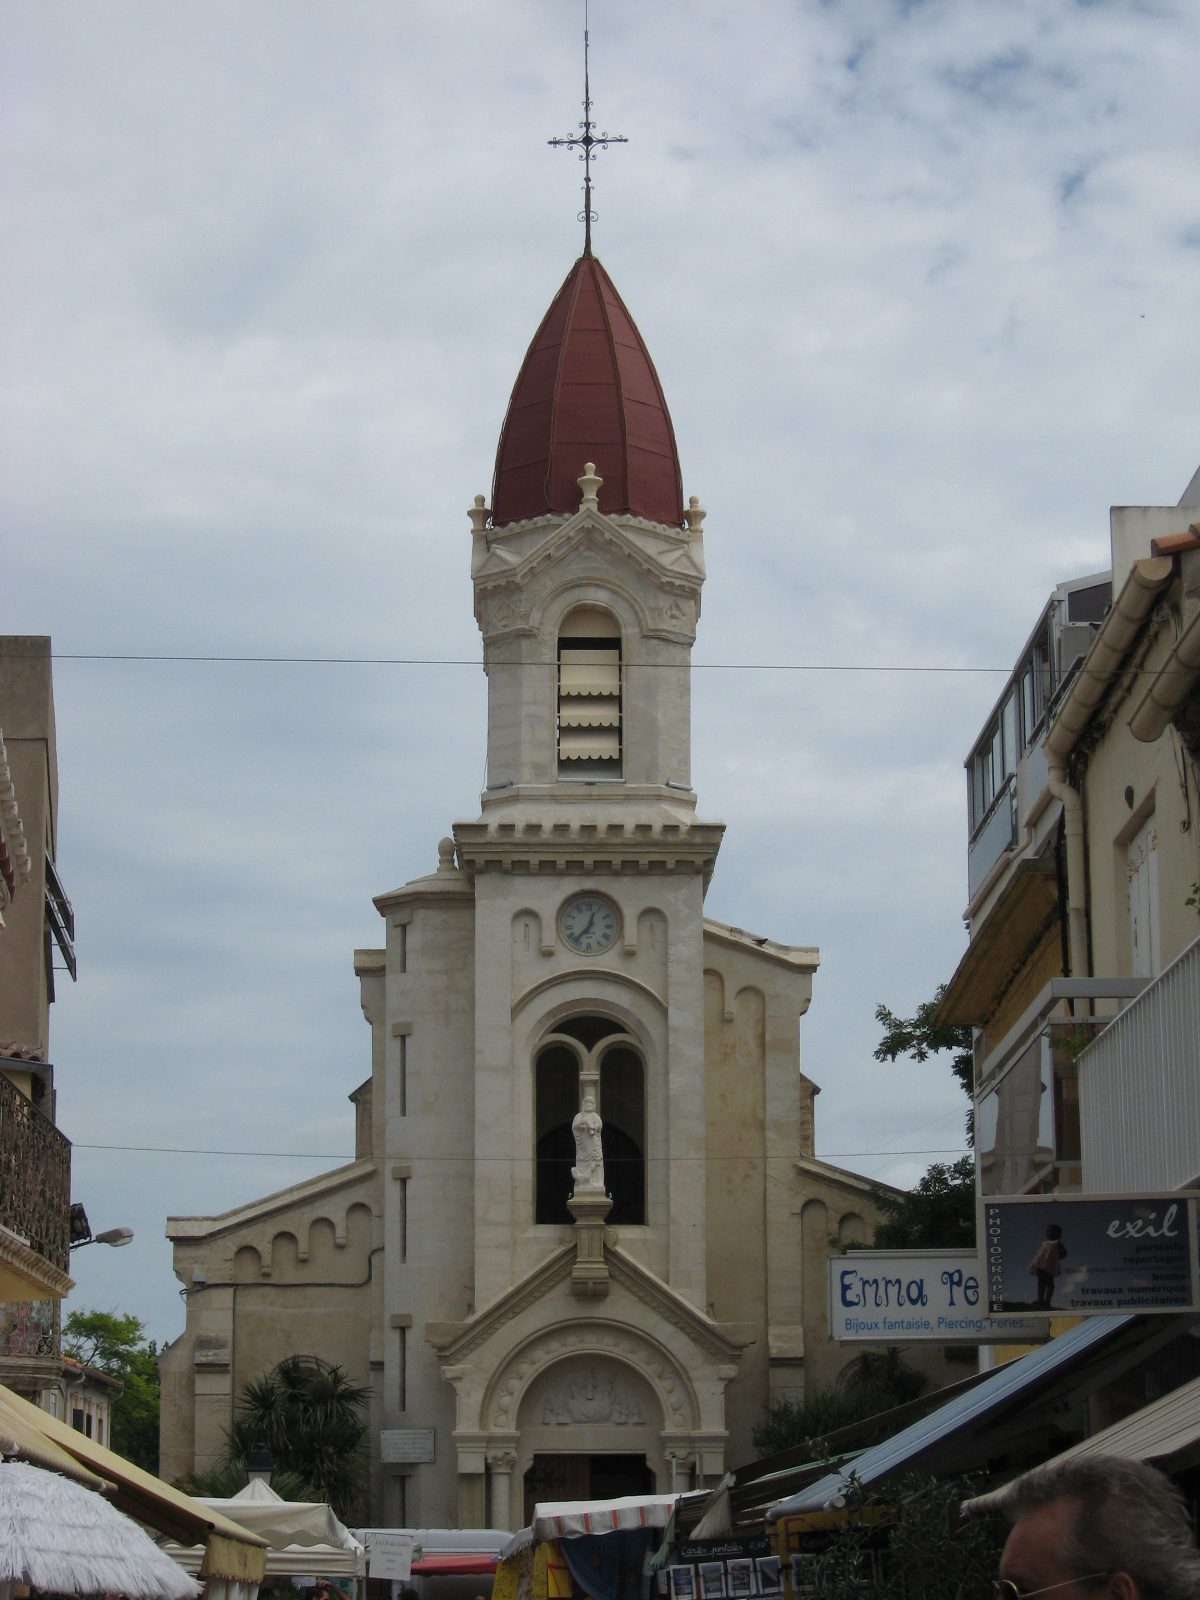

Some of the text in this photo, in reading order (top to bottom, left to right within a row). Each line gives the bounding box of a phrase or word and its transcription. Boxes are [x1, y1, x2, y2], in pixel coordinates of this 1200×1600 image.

[1105, 1204, 1178, 1238] exil
[989, 1208, 1003, 1311] PHOTOGRAPHE
[840, 1269, 928, 1308] Emma
[1070, 1295, 1187, 1308] travaux publicitaires
[1081, 1286, 1124, 1295] travaux
[845, 1317, 879, 1334] Bijoux
[882, 1316, 934, 1332] fantaisie,
